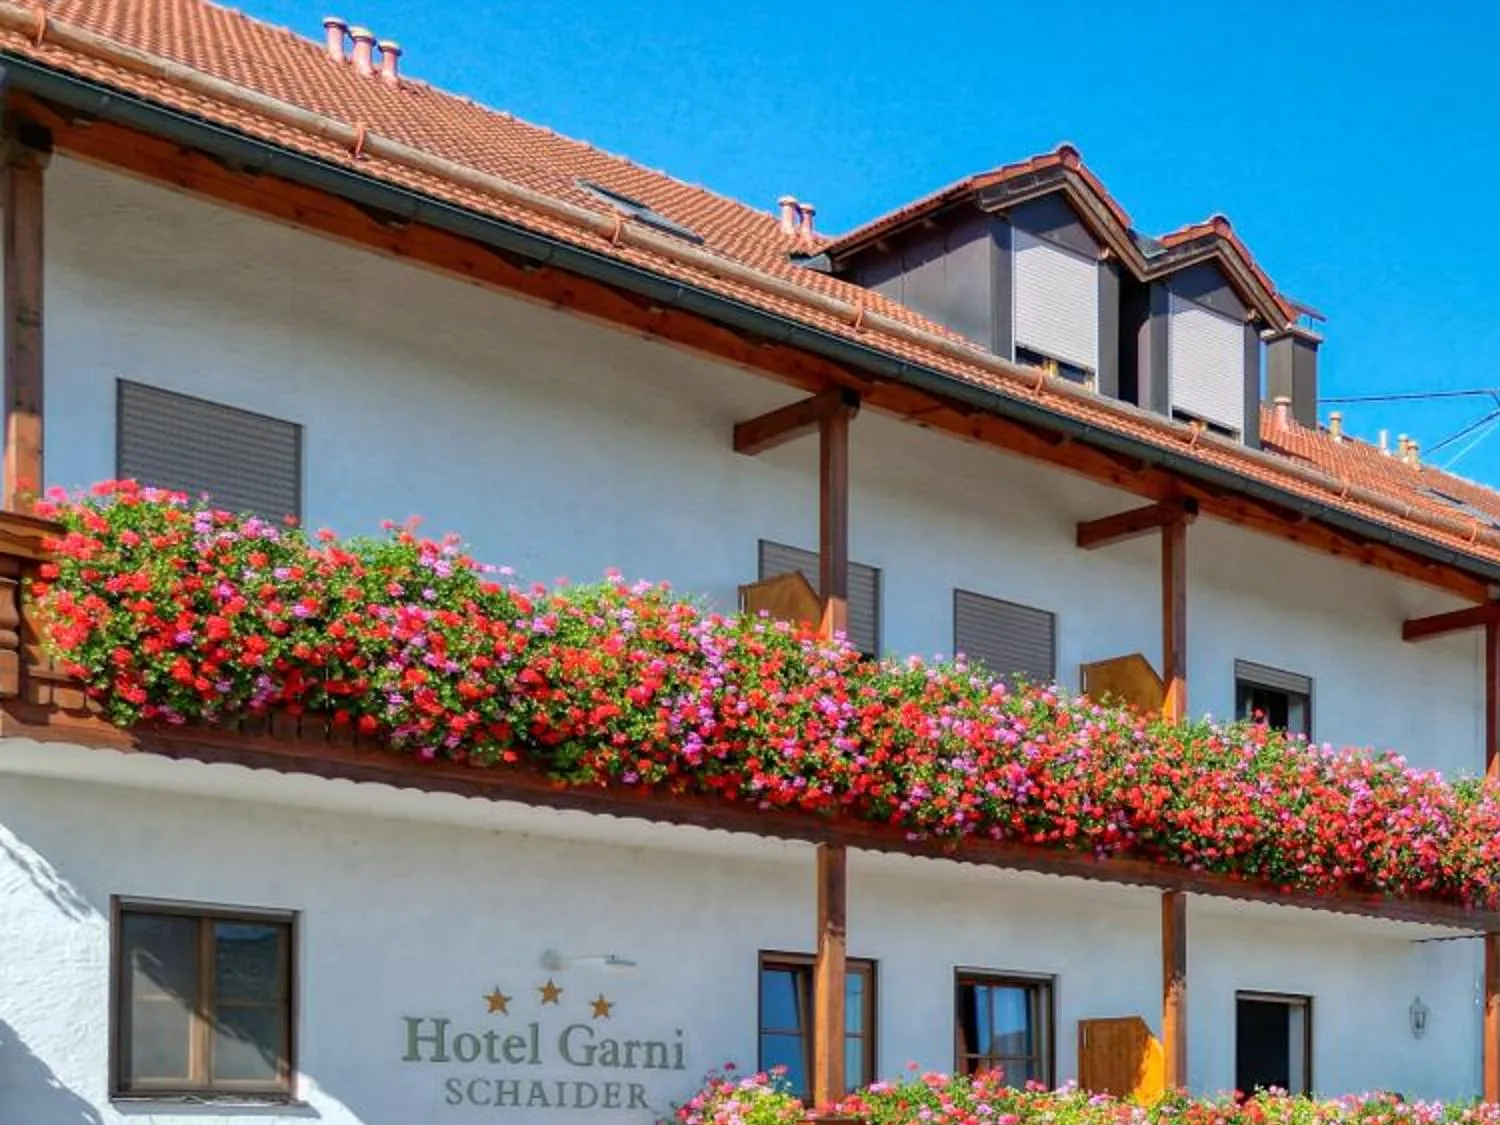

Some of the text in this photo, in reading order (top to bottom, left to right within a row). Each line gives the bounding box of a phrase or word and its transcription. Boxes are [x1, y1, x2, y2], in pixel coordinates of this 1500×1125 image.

[401, 1016, 687, 1070] Hotel Garni
[444, 1078, 650, 1109] SCHAIDER
